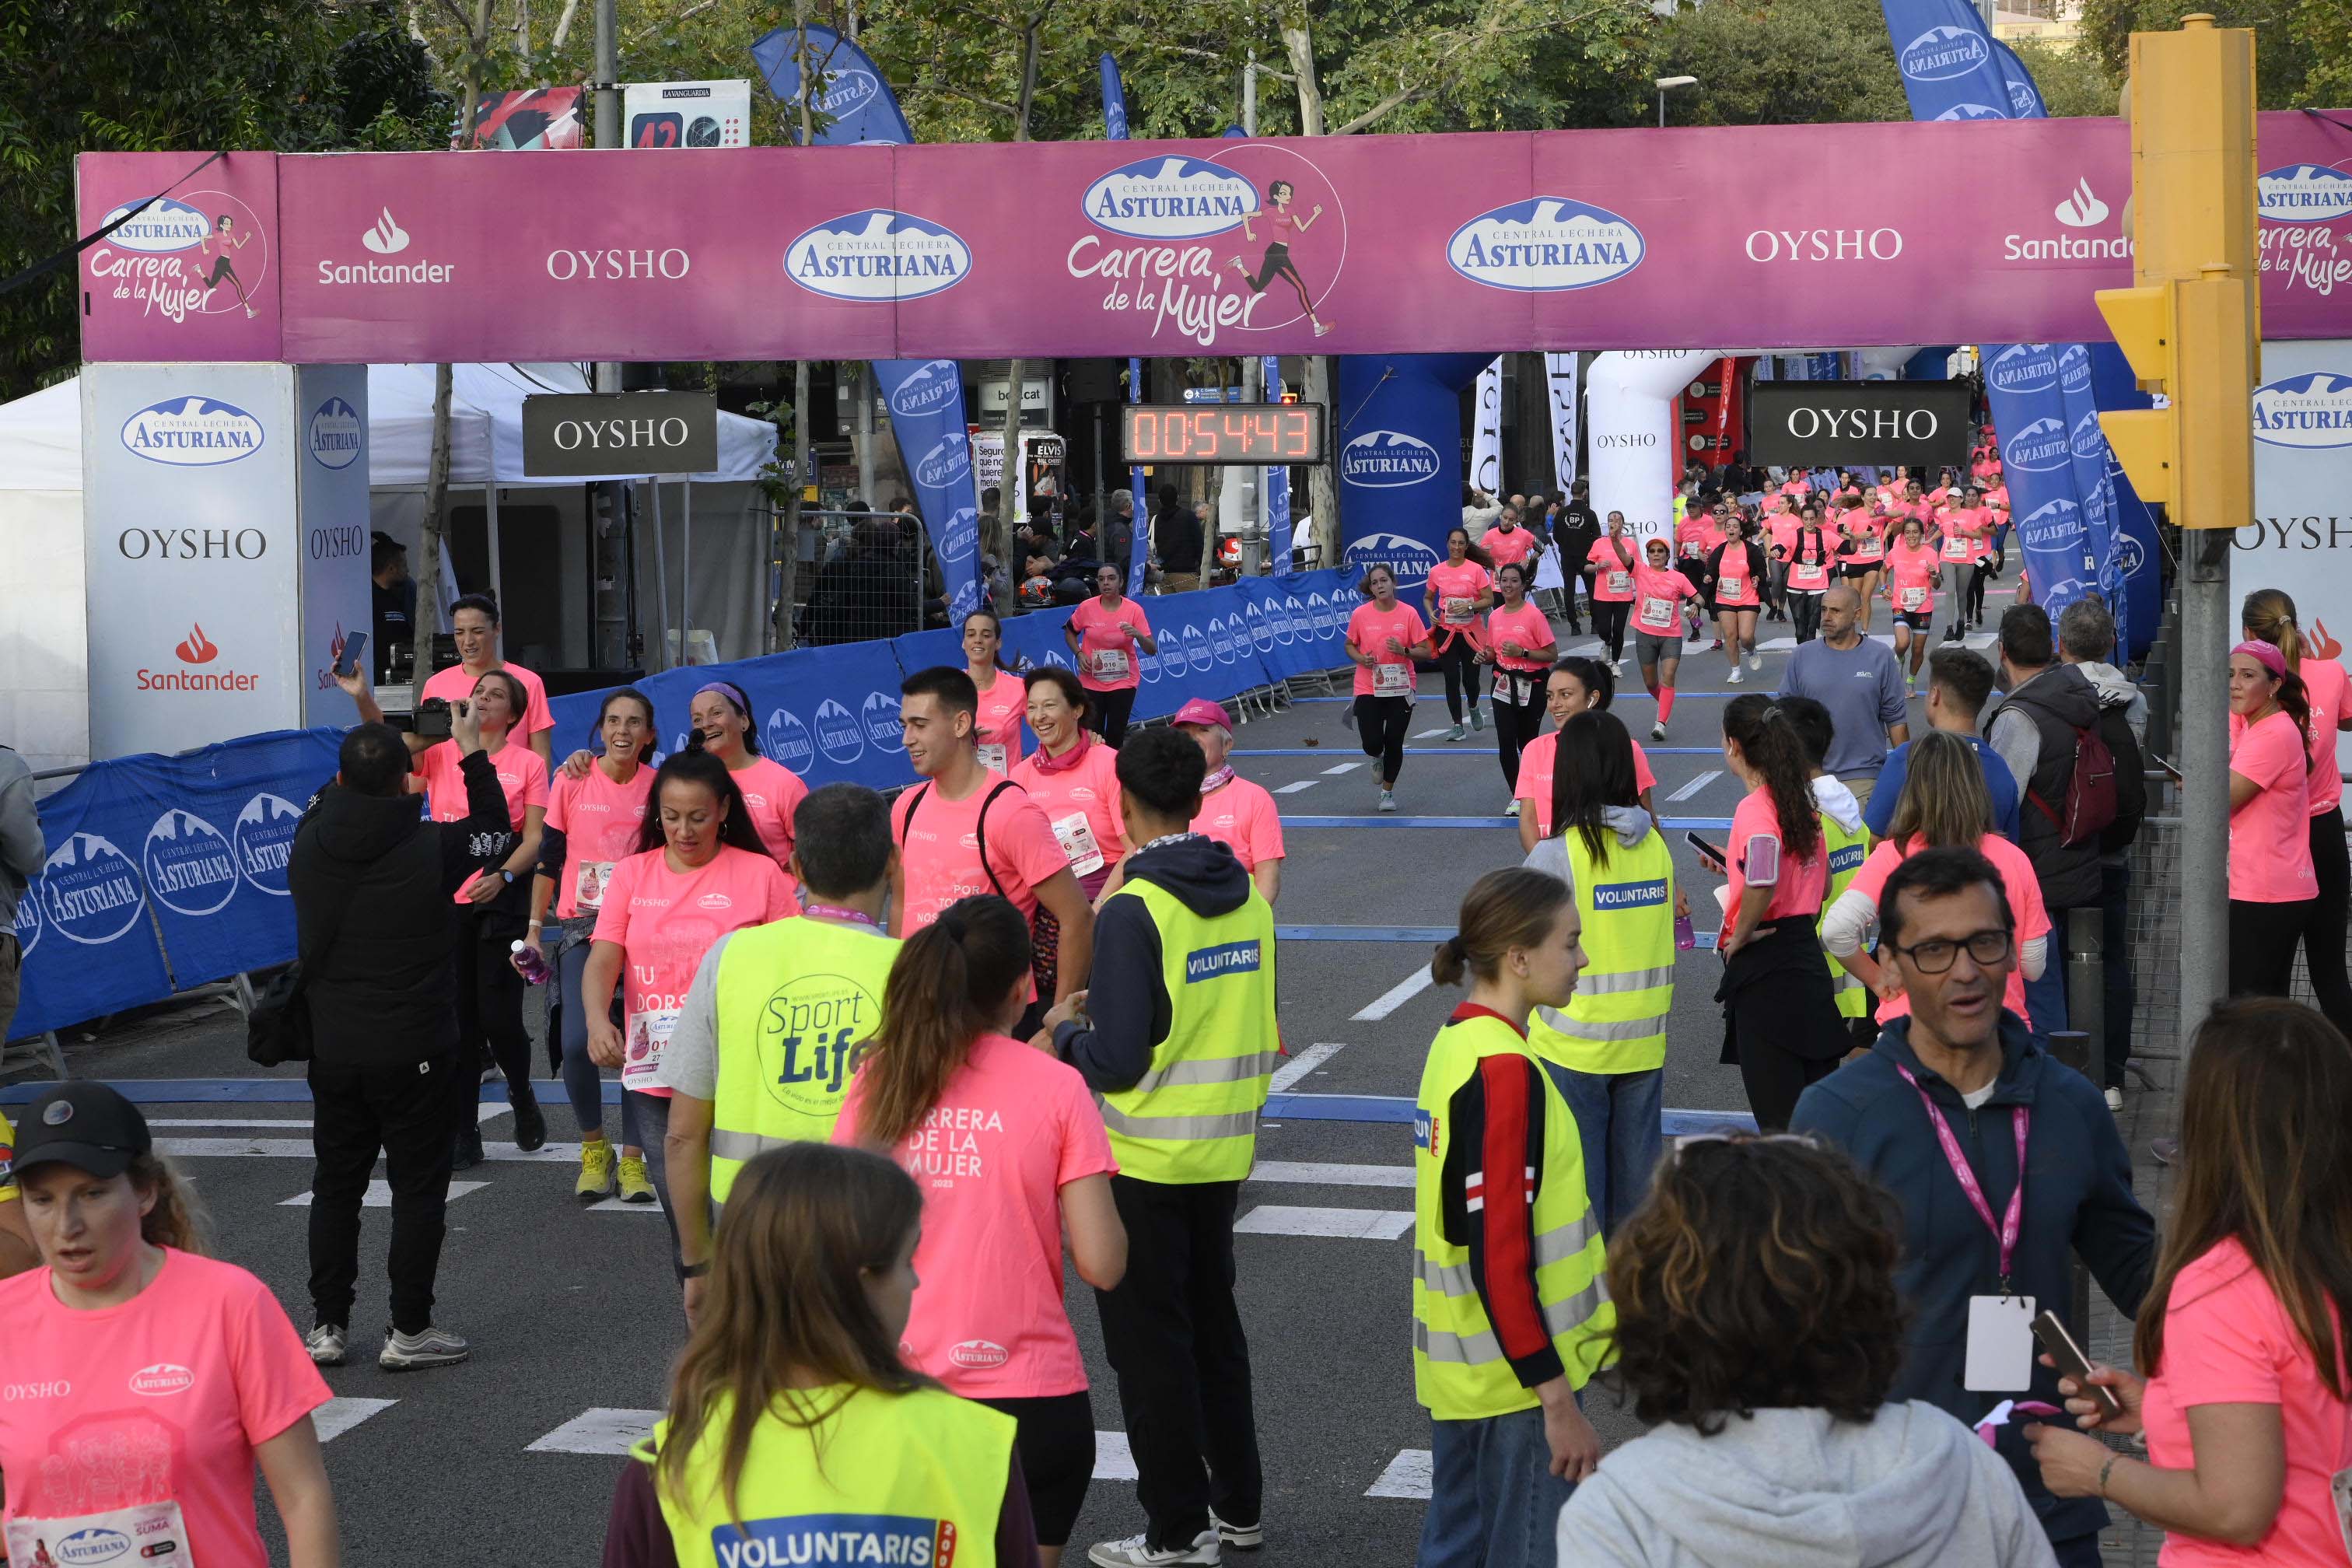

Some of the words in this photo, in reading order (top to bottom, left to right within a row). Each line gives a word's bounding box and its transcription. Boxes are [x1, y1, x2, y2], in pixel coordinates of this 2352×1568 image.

[1123, 184, 1178, 194] CENTRAL
[1185, 183, 1241, 193] LECHERA
[1095, 187, 1244, 219] ASTURIANA
[827, 241, 886, 250] CENTRAL
[891, 240, 951, 250] LECHERA
[1493, 230, 1553, 240] CENTRAL
[1559, 228, 1623, 238] LECHERA
[1745, 228, 1903, 262] OYSHO
[2258, 226, 2332, 249] arrera
[1067, 235, 1213, 278] Carrera
[1462, 233, 1629, 268] ASTURIANA
[2005, 235, 2134, 261] Santand
[90, 248, 182, 278] Carrera
[319, 260, 454, 284] Santander
[547, 248, 690, 280] OYSHO
[799, 244, 957, 278] ASTURIANA
[2276, 250, 2290, 271] la
[2285, 245, 2352, 296] Muje
[113, 279, 130, 299] de
[134, 278, 146, 299] la
[144, 275, 217, 323] Mujer
[1102, 281, 1129, 311] de
[1136, 281, 1155, 310] la
[1151, 274, 1267, 346] Mujer
[132, 421, 254, 449] ASTURIANA
[554, 417, 689, 450] OYSHO
[1133, 411, 1309, 456] 00:54:43
[1788, 408, 1938, 440] OYSHO
[313, 424, 359, 452] ASTURIANA
[1598, 433, 1656, 448] OYSHO
[980, 458, 992, 467] que
[1038, 446, 1061, 456] ELVIS
[1345, 453, 1432, 475] ASTURIANA
[119, 528, 267, 559] OYSHO
[311, 525, 363, 561] OYSHO
[137, 669, 259, 691] Santander
[772, 736, 811, 761] ASTURIANA
[819, 726, 861, 750] ASTURIANA
[579, 803, 611, 813] OYSHO
[250, 828, 278, 841] CENTRAL
[163, 846, 191, 859] CENTRAL
[193, 840, 222, 854] LECHERA
[153, 853, 234, 894] ASTURIANA
[51, 876, 138, 923] ASTURIANA
[632, 897, 670, 908] OYSHO
[954, 885, 980, 895] POR
[1595, 885, 1665, 905] VOLUNTARIS
[1187, 947, 1259, 975] VOLUNTARIS
[634, 964, 655, 984] TU
[768, 992, 863, 1038] Sport
[924, 1108, 1003, 1132] RRERA
[909, 1129, 940, 1151] DE
[949, 1131, 978, 1153] LA
[906, 1152, 982, 1177] MUJER
[952, 1350, 1004, 1364] ASTURIANA
[5, 1381, 71, 1400] OYSHO
[135, 1374, 191, 1391] ASTURIANA
[62, 1542, 126, 1559] ASTURIANA
[719, 1531, 932, 1568] VOLUNTARIS
